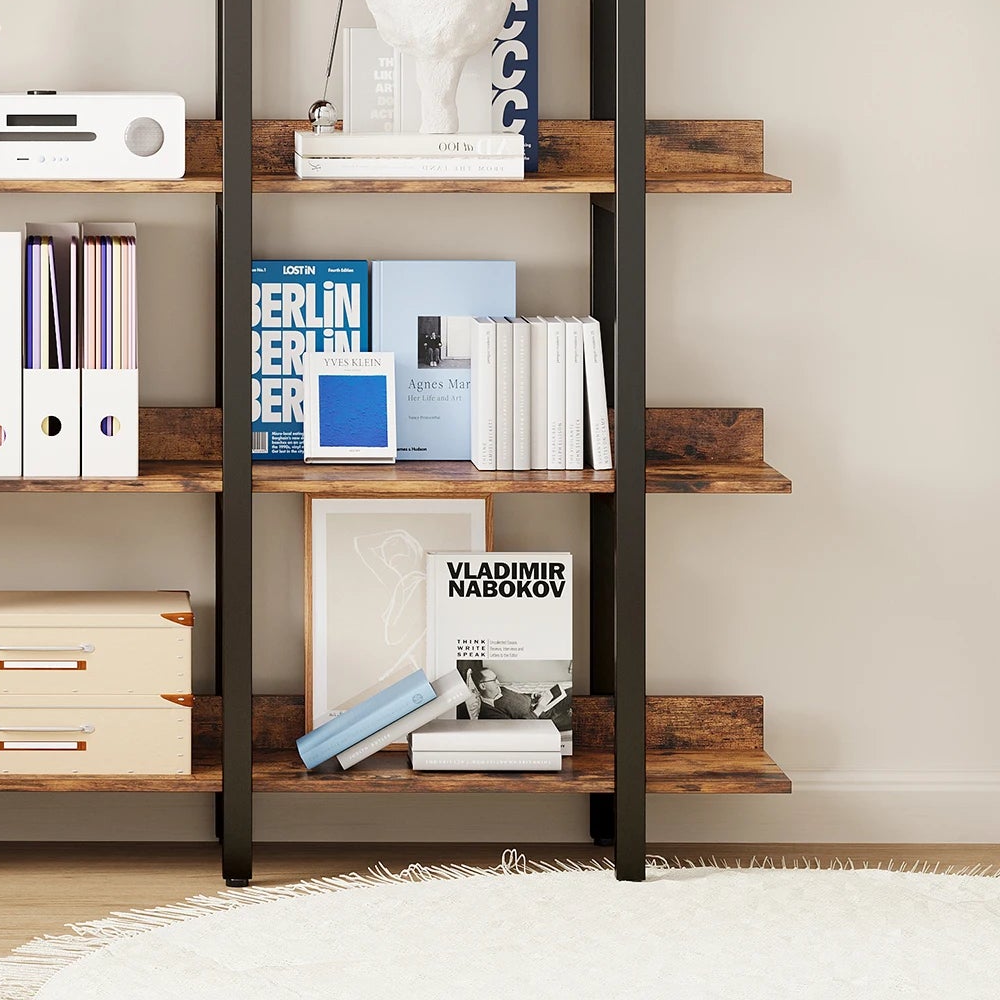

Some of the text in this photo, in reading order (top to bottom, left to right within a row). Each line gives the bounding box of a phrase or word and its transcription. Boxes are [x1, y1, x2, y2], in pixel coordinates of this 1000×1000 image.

[283, 266, 304, 275] LOST
[324, 358, 381, 366] YVES KLEIN
[408, 379, 471, 392] Agnes Mar
[447, 562, 565, 580] VLADIMIR
[449, 580, 565, 598] NABOKOV
